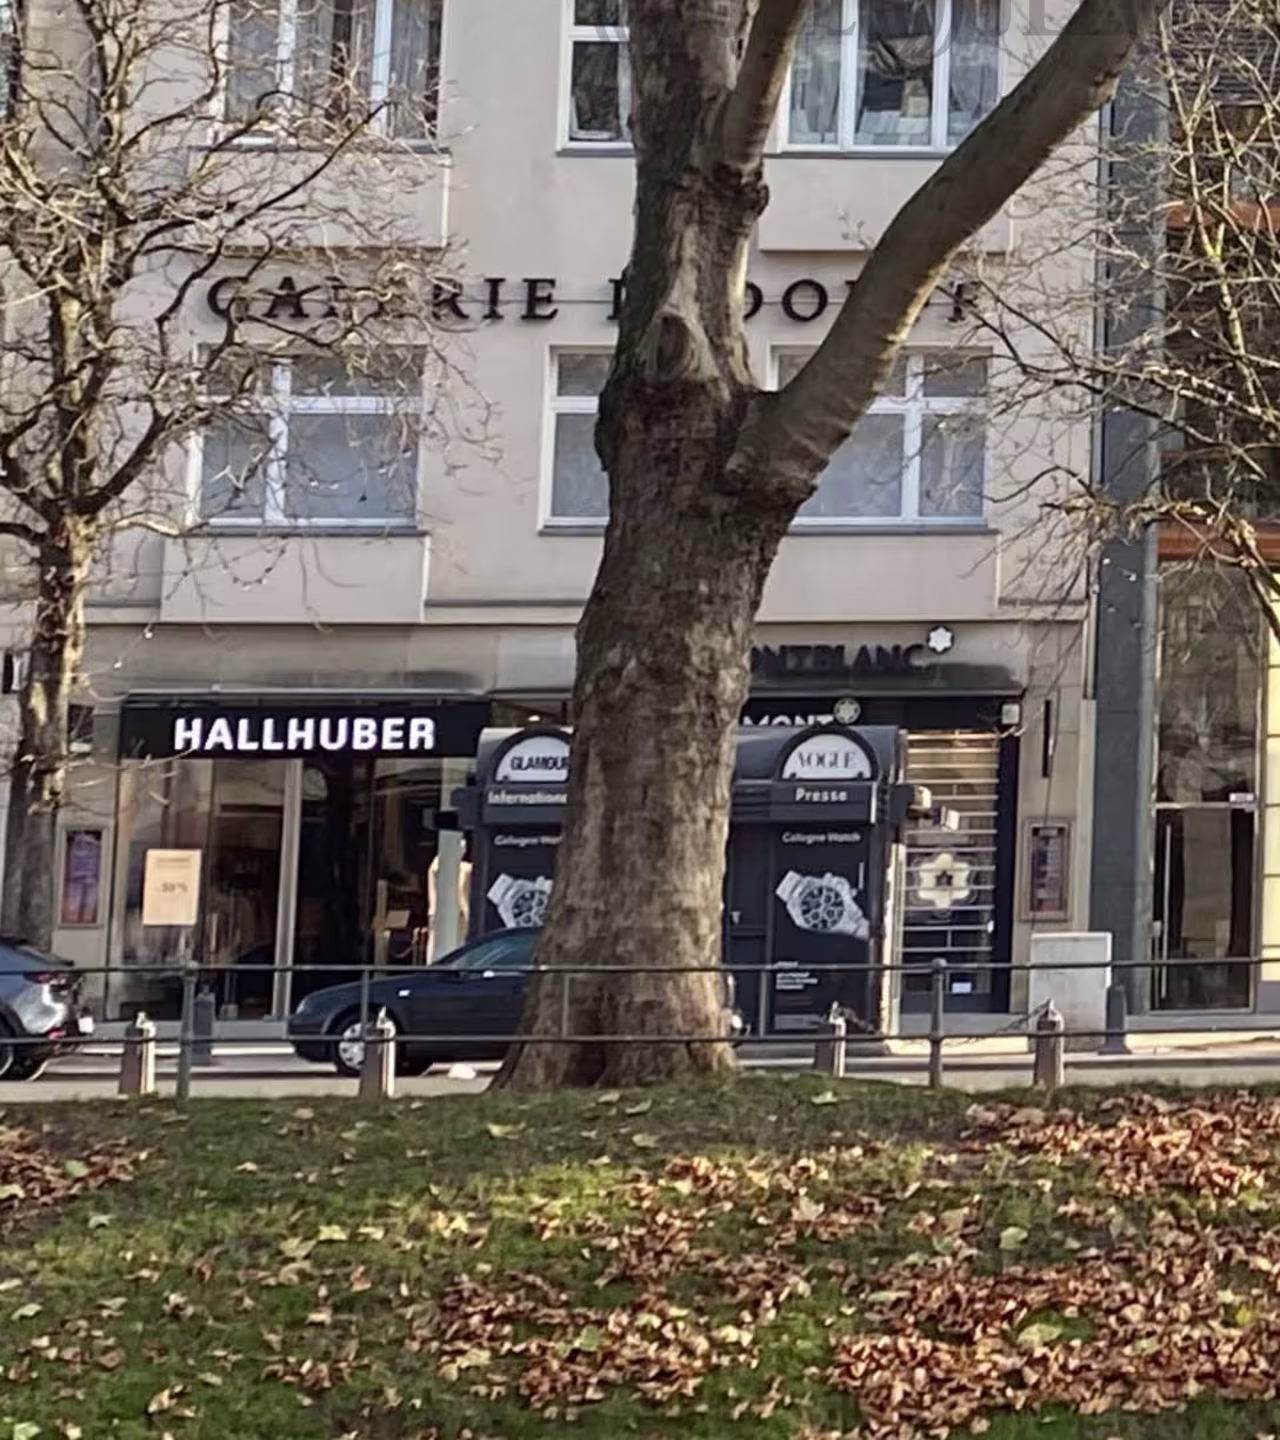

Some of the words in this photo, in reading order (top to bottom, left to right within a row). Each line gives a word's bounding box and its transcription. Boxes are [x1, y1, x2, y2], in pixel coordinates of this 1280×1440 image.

[174, 717, 435, 751] HALLHUBER
[797, 752, 856, 768] VOGUE
[795, 788, 848, 802] Presse
